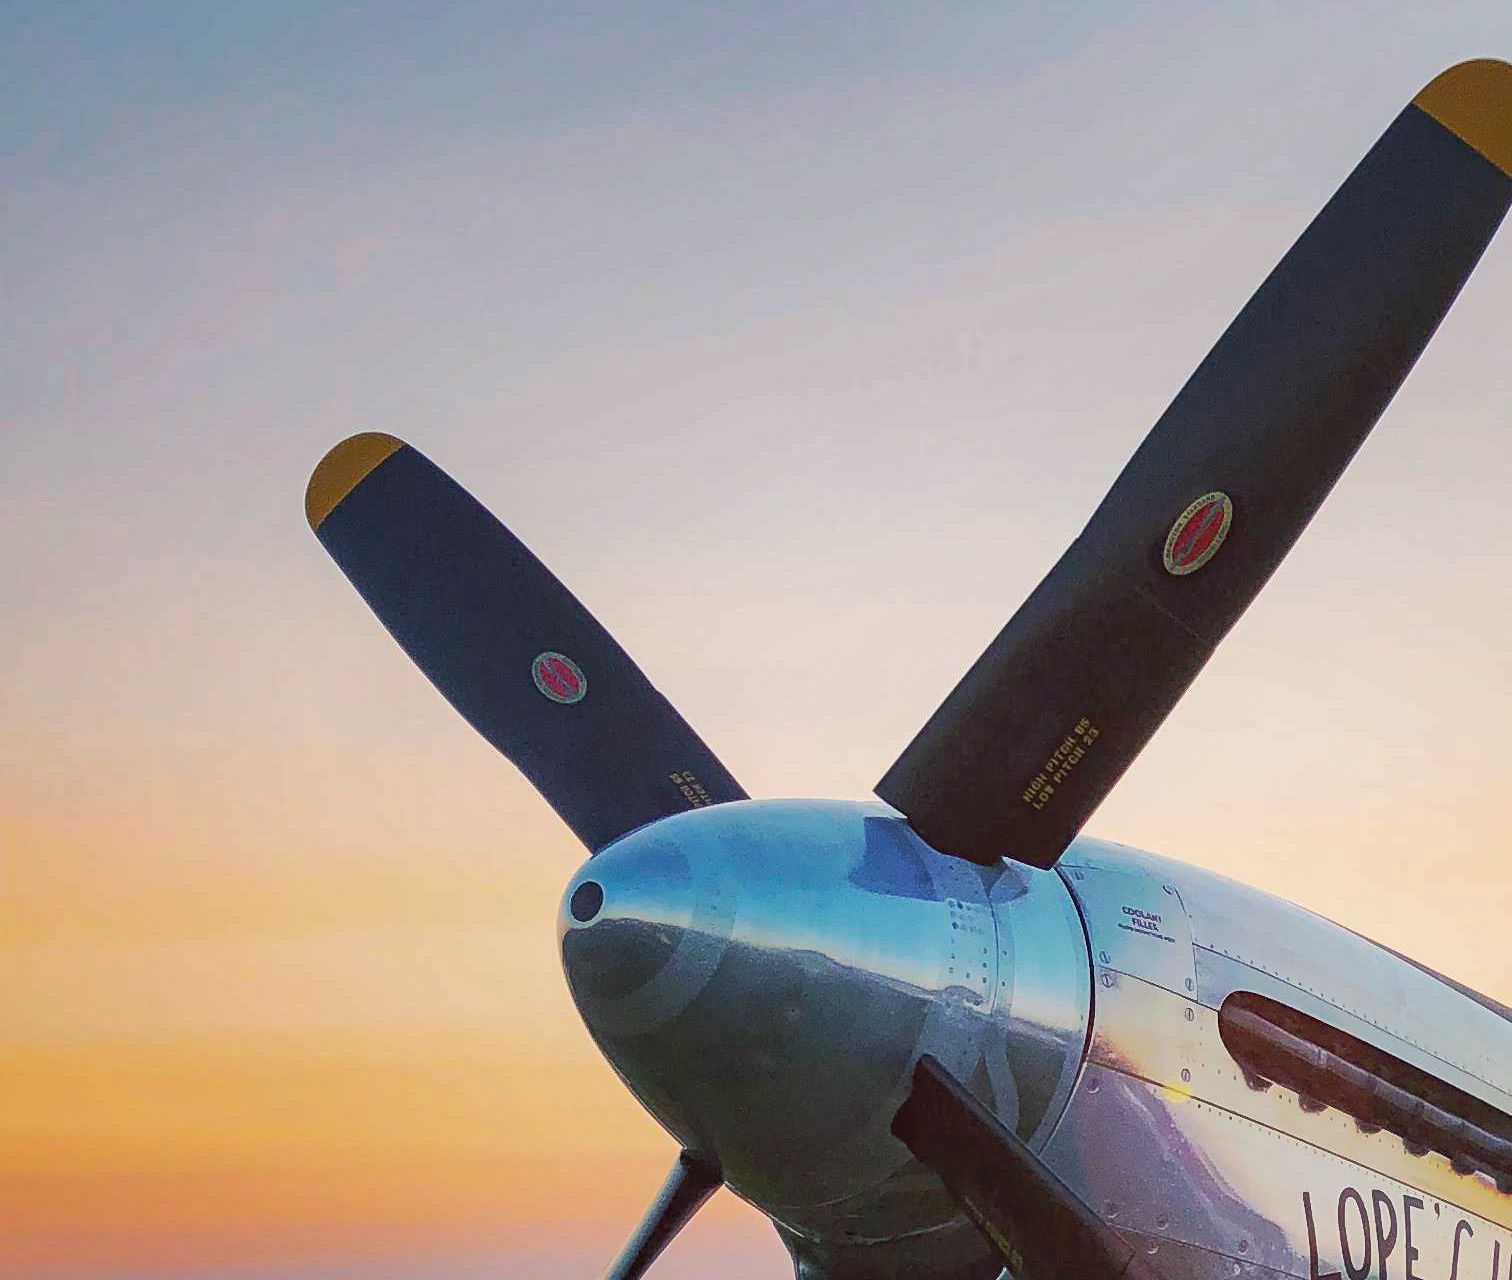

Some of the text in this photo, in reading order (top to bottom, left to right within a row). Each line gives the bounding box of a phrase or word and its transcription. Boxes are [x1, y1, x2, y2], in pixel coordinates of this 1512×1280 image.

[1045, 736, 1077, 773] PITCH
[1053, 747, 1086, 784] PITCH
[1122, 906, 1162, 923] COOLANT
